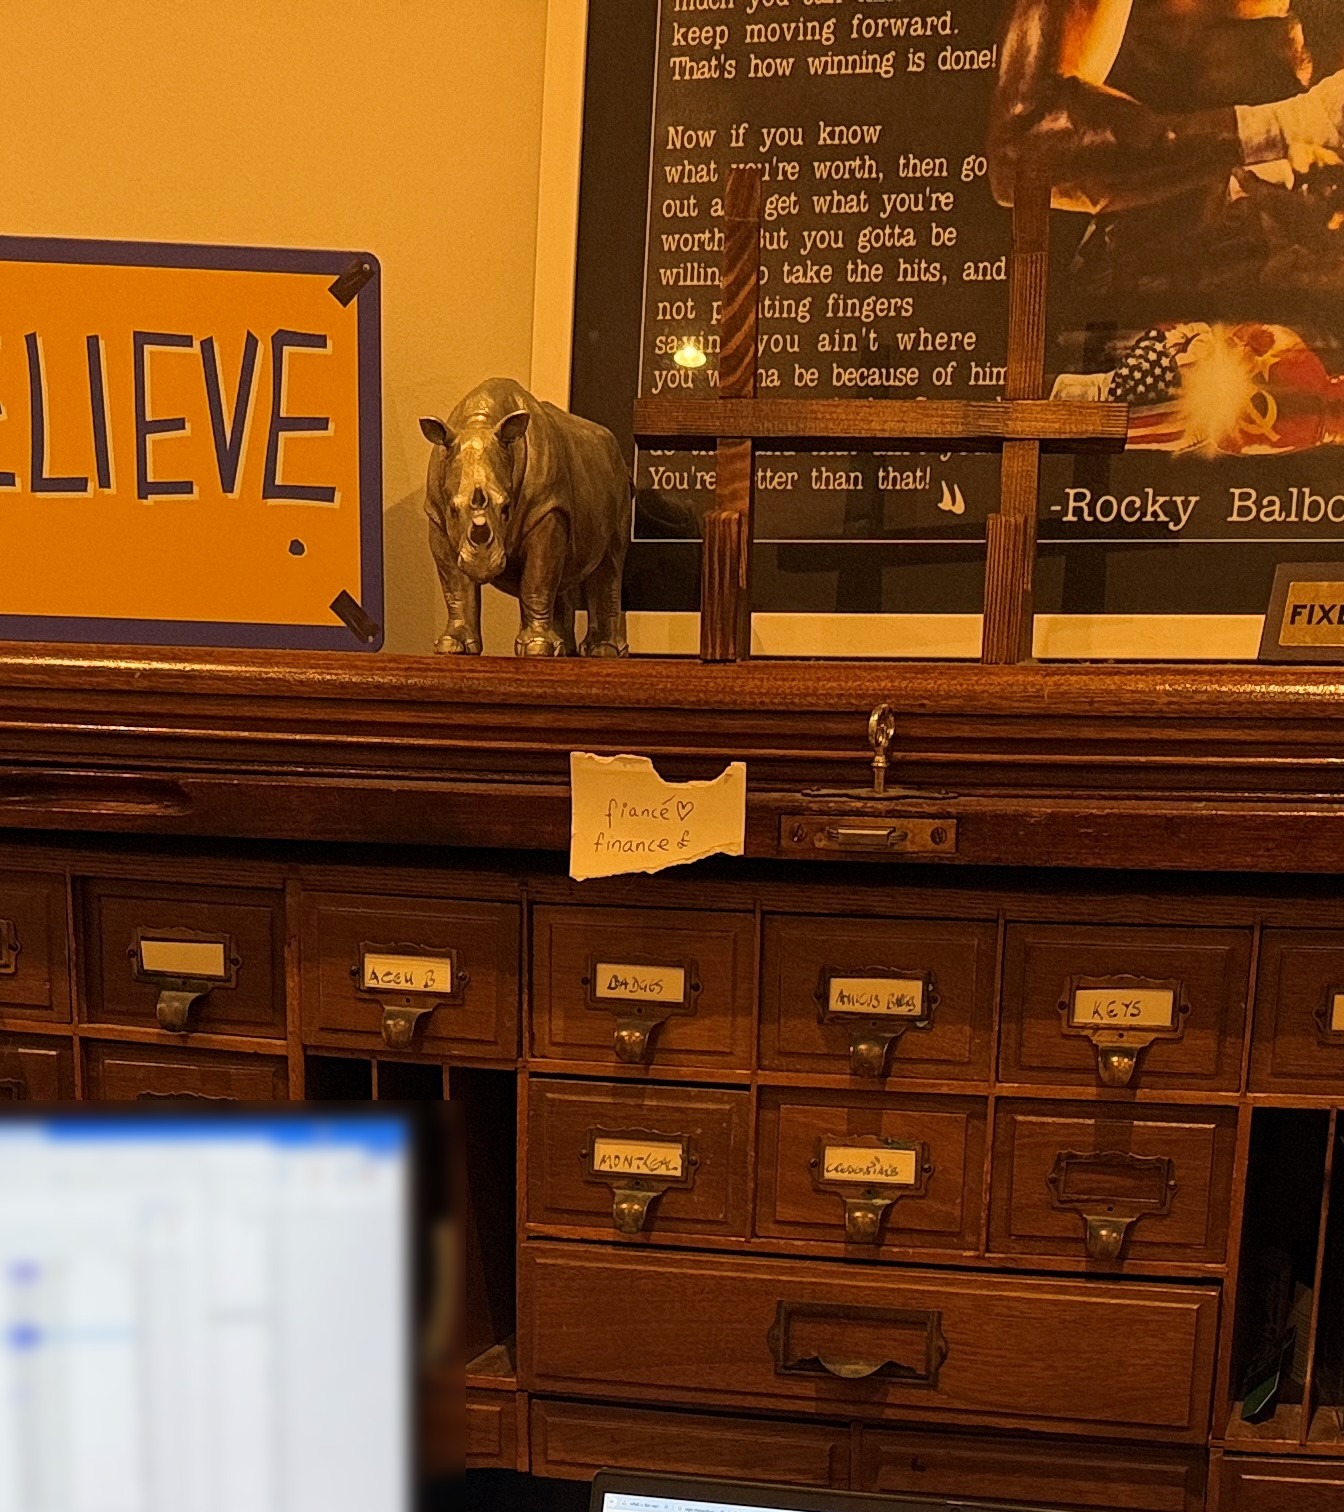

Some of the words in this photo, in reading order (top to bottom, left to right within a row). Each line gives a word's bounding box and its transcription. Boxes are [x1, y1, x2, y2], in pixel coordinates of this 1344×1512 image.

[672, 23, 728, 49] keep
[745, 17, 836, 45] moving
[851, 11, 959, 38] forward.
[670, 54, 736, 81] That's
[749, 54, 794, 78] how
[807, 51, 895, 78] winning
[907, 48, 925, 72] is
[938, 44, 998, 71] done!
[666, 126, 716, 149] Now
[730, 124, 748, 147] if
[759, 126, 803, 152] you
[818, 122, 882, 145] know
[665, 160, 718, 183] what
[814, 160, 884, 183] worth,
[898, 156, 948, 178] then
[961, 157, 987, 181] go
[662, 195, 698, 218] out
[765, 192, 799, 220] get
[812, 190, 868, 213] what
[880, 187, 954, 219] you're
[760, 227, 788, 250] ut
[800, 229, 844, 255] you
[858, 227, 916, 253] gotta
[931, 223, 956, 246] be
[659, 263, 724, 289] willin
[783, 260, 832, 284] take
[846, 257, 883, 282] the
[897, 255, 948, 285] hits,
[962, 257, 1006, 281] and
[656, 298, 696, 320] not
[825, 293, 913, 322] fingers
[757, 334, 800, 360] you
[817, 328, 879, 352] ain't
[897, 327, 976, 351] where
[652, 368, 692, 394] you
[794, 365, 819, 388] be
[832, 362, 919, 388] because
[932, 361, 957, 386] of
[649, 466, 717, 490] You're
[755, 467, 798, 490] tter
[810, 466, 863, 490] than
[878, 466, 931, 490] that!
[1050, 489, 1199, 532] -Rocky
[604, 794, 675, 828] fiancé
[594, 832, 669, 854] finance
[1092, 1000, 1142, 1020] KEYS
